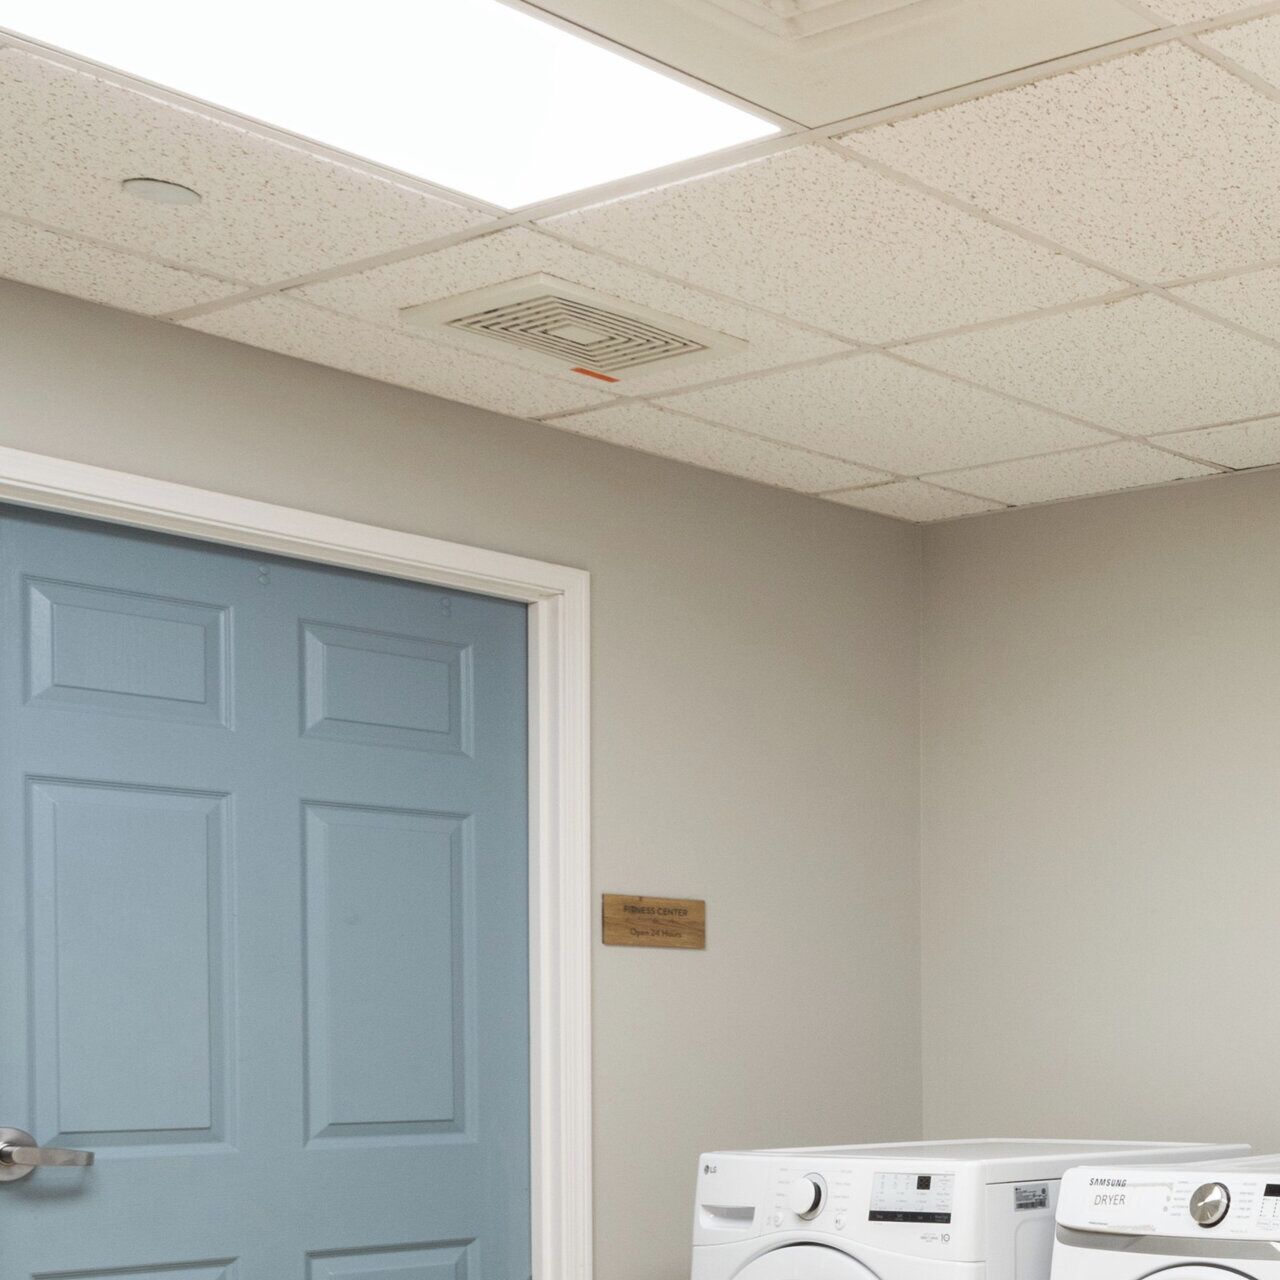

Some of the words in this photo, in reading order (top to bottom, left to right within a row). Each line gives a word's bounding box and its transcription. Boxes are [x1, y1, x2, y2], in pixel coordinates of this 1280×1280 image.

[656, 907, 689, 917] CENTER
[630, 927, 650, 938] Open
[1089, 1178, 1127, 1188] SAMSUNG
[1094, 1194, 1126, 1206] DRYER
